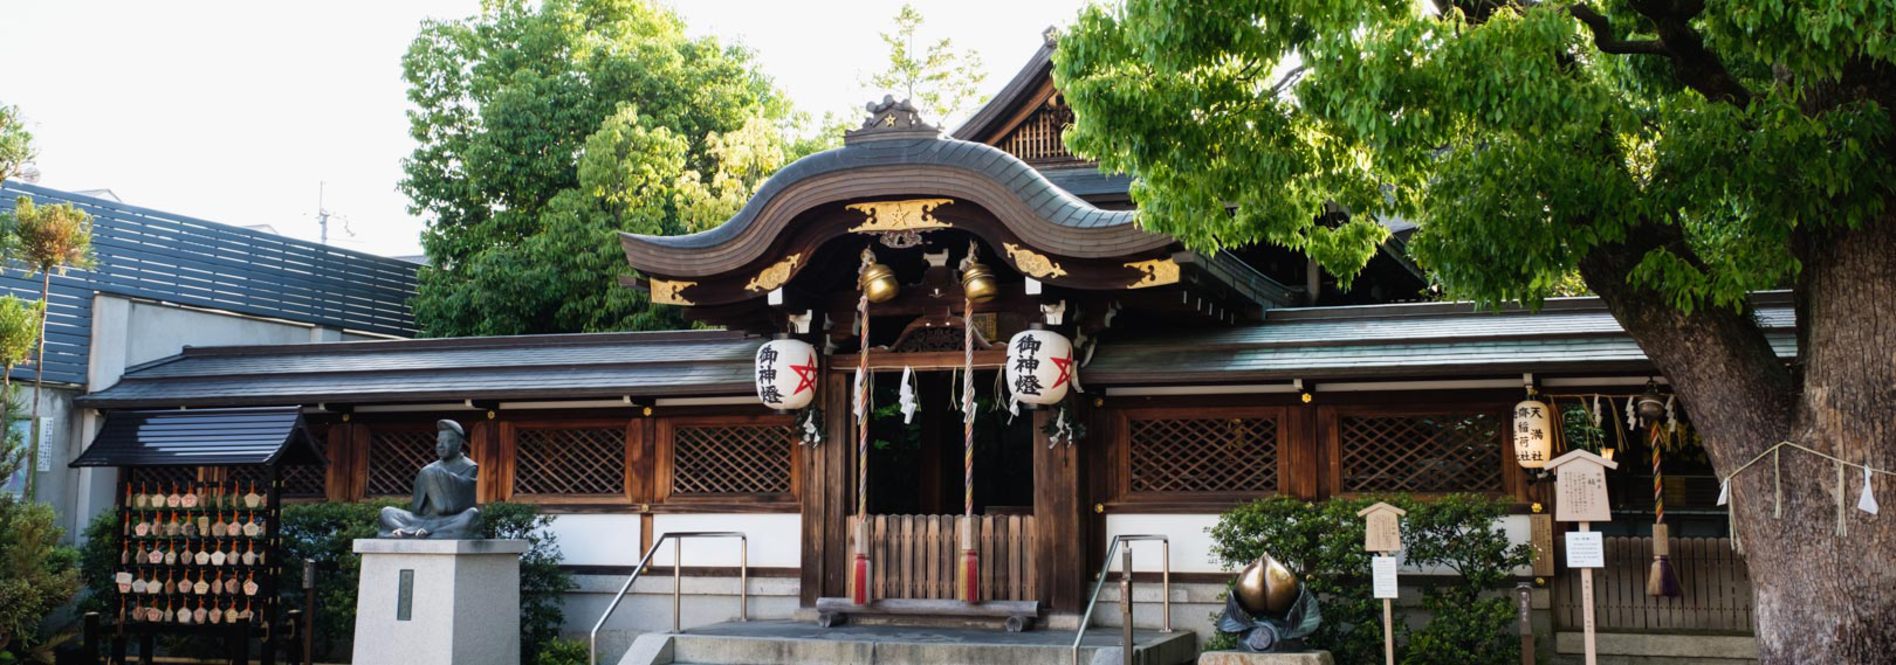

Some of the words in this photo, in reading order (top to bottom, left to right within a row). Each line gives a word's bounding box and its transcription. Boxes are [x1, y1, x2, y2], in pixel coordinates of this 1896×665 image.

[758, 344, 784, 404] 御神燈
[1014, 333, 1044, 396] 御神燈
[1530, 406, 1544, 461] 天満社
